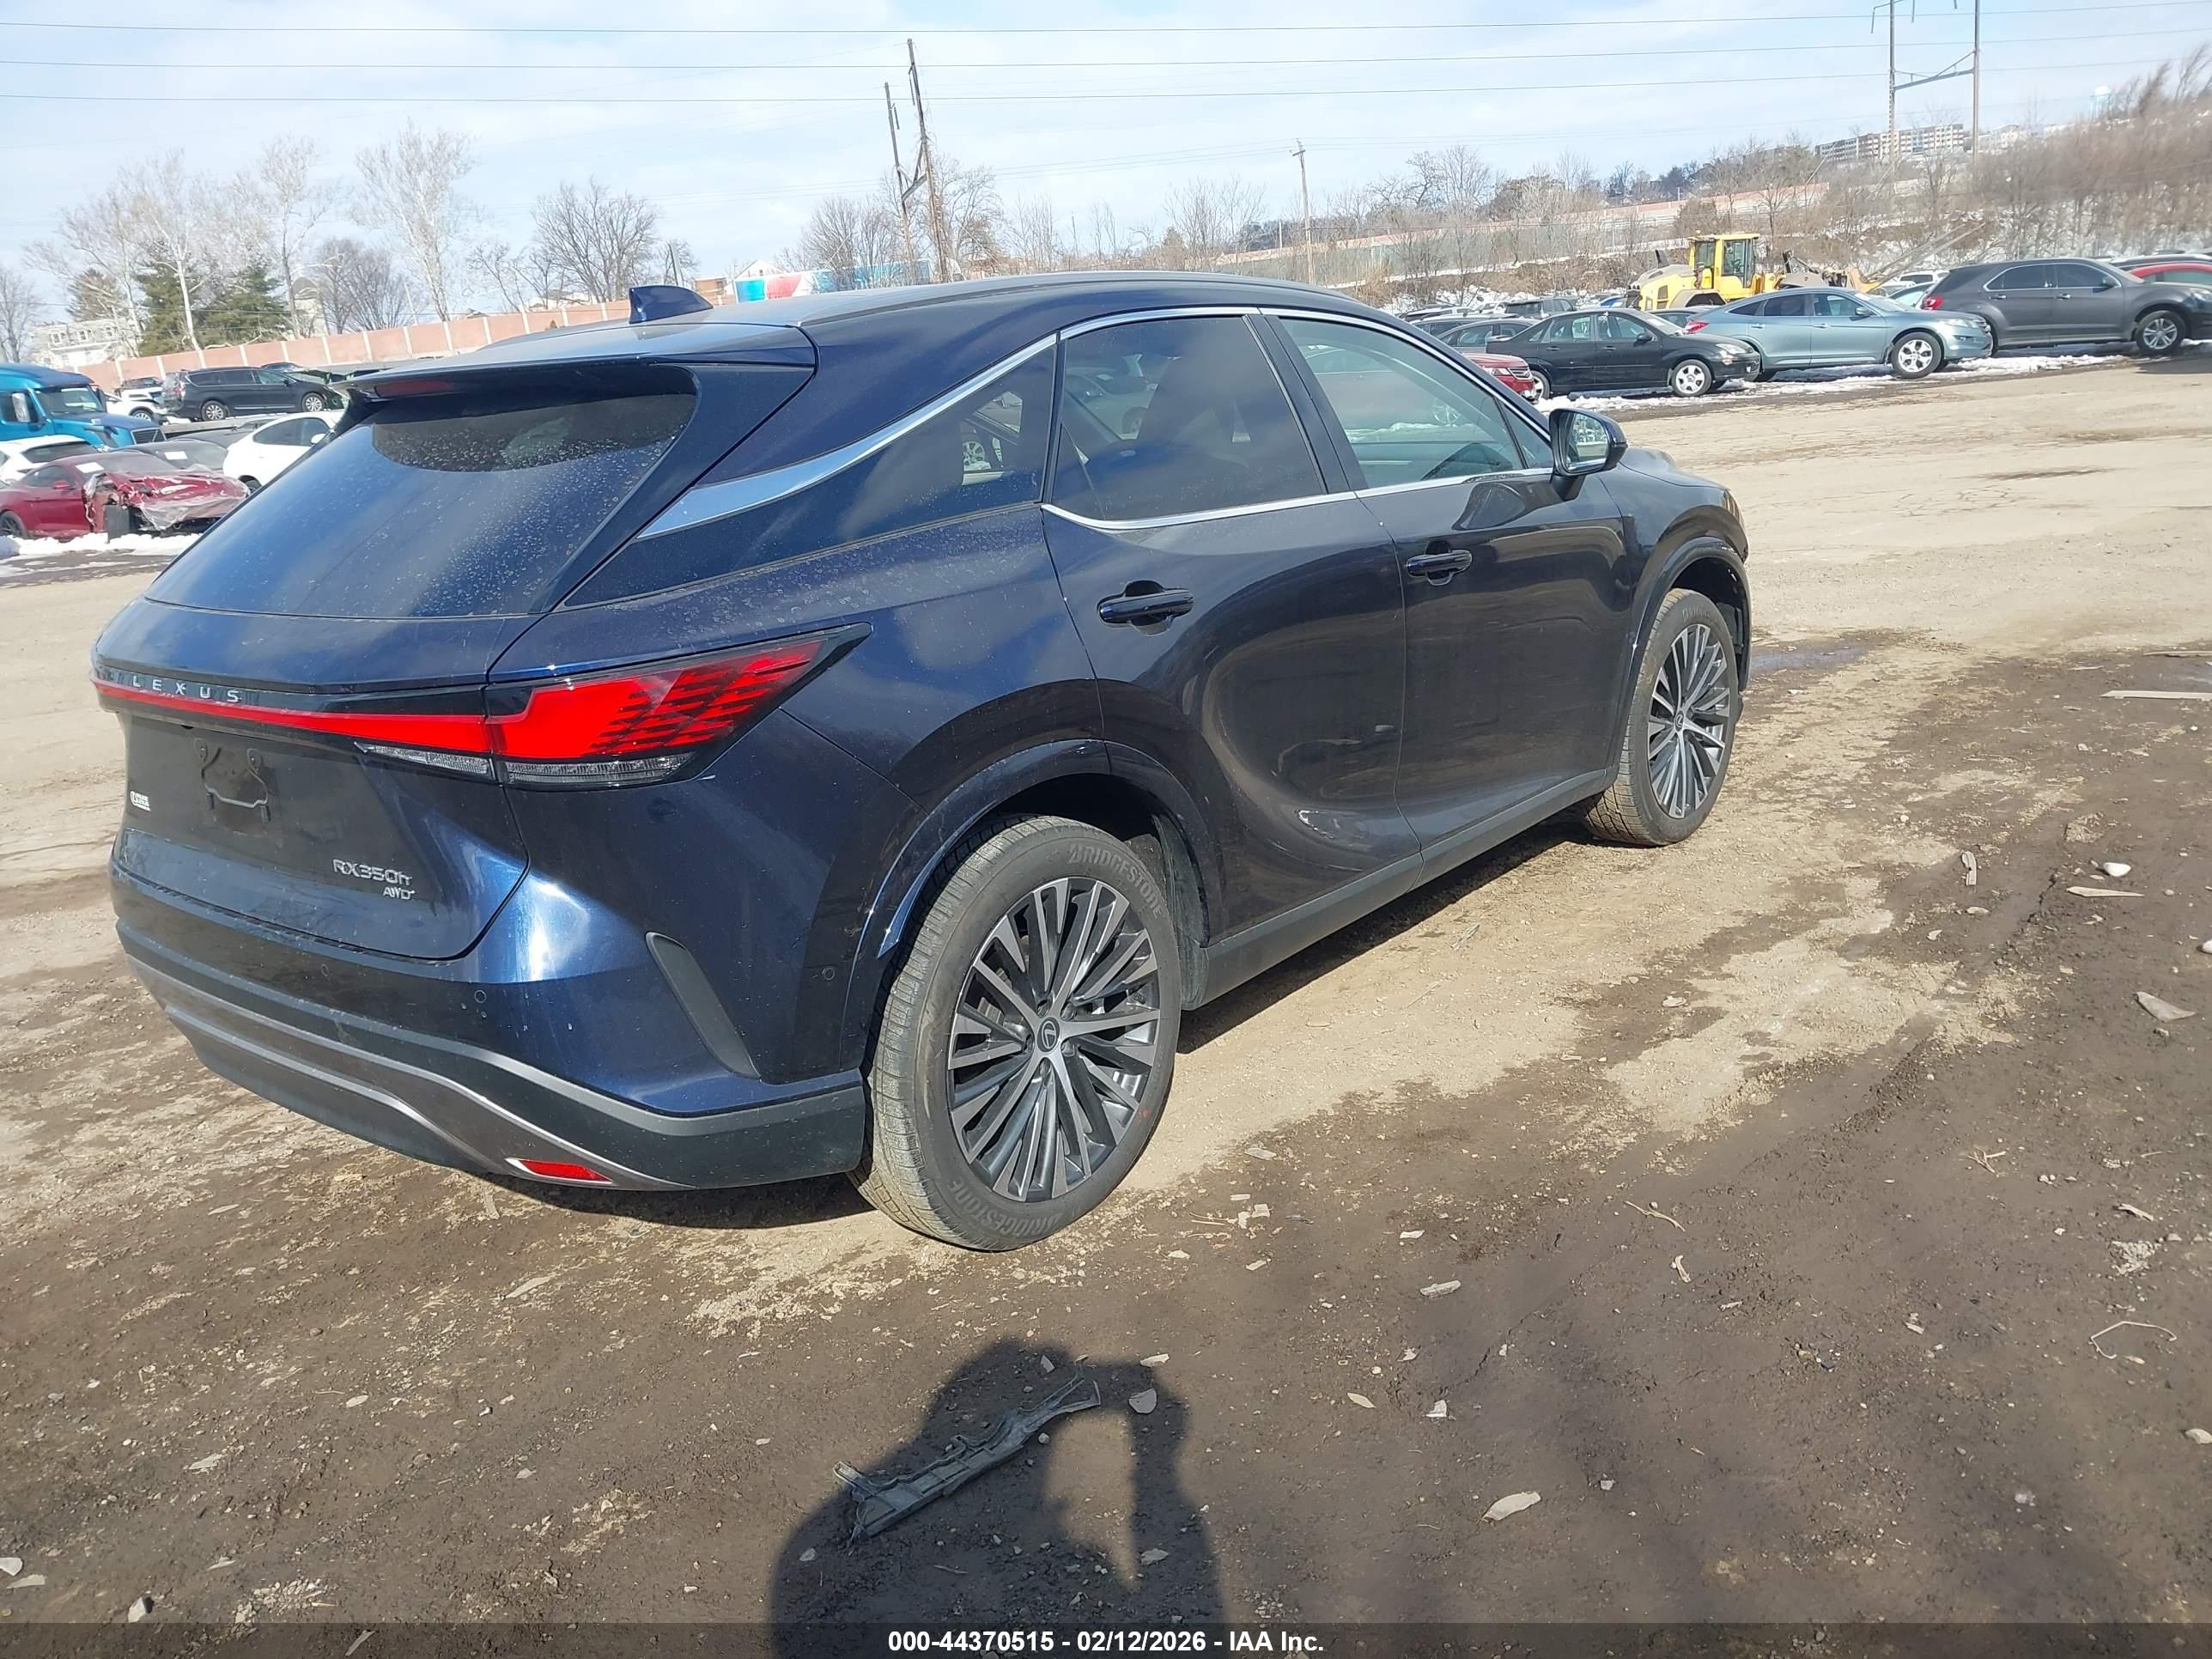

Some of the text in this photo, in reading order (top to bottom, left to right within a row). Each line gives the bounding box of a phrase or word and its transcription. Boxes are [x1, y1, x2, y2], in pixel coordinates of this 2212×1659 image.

[132, 675, 241, 702] LEXUS
[332, 859, 412, 885] RX350h
[383, 886, 416, 900] AWD
